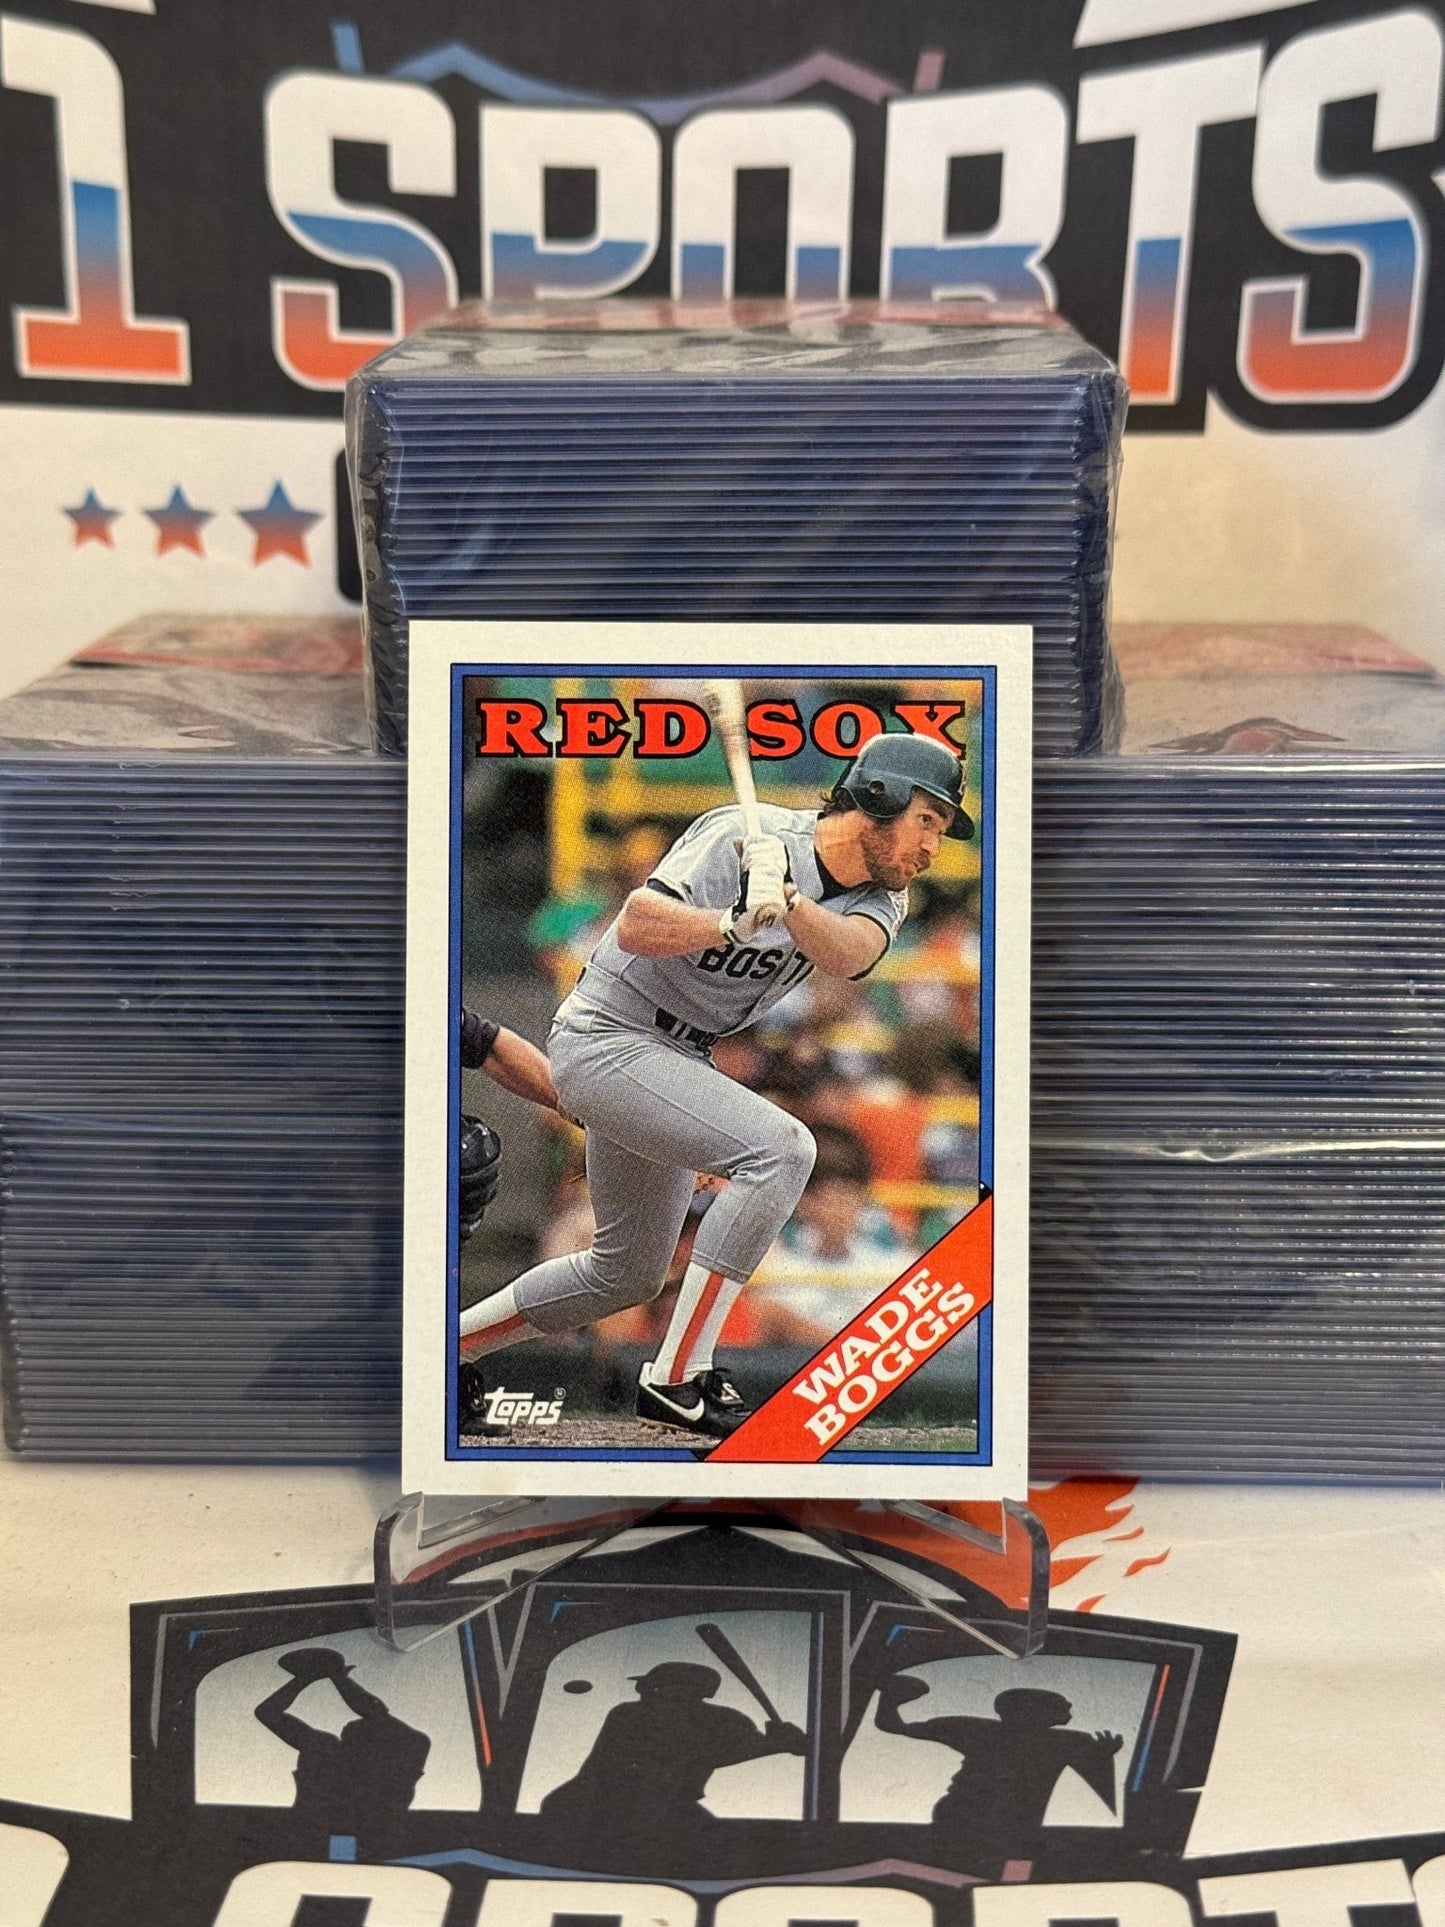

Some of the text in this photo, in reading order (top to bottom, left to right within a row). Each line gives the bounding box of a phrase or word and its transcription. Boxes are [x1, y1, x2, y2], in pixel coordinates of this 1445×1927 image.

[264, 11, 1443, 404] SPORTS
[476, 698, 967, 760] RED SOX
[792, 1267, 944, 1405] WADE
[804, 1281, 976, 1446] BOGGS
